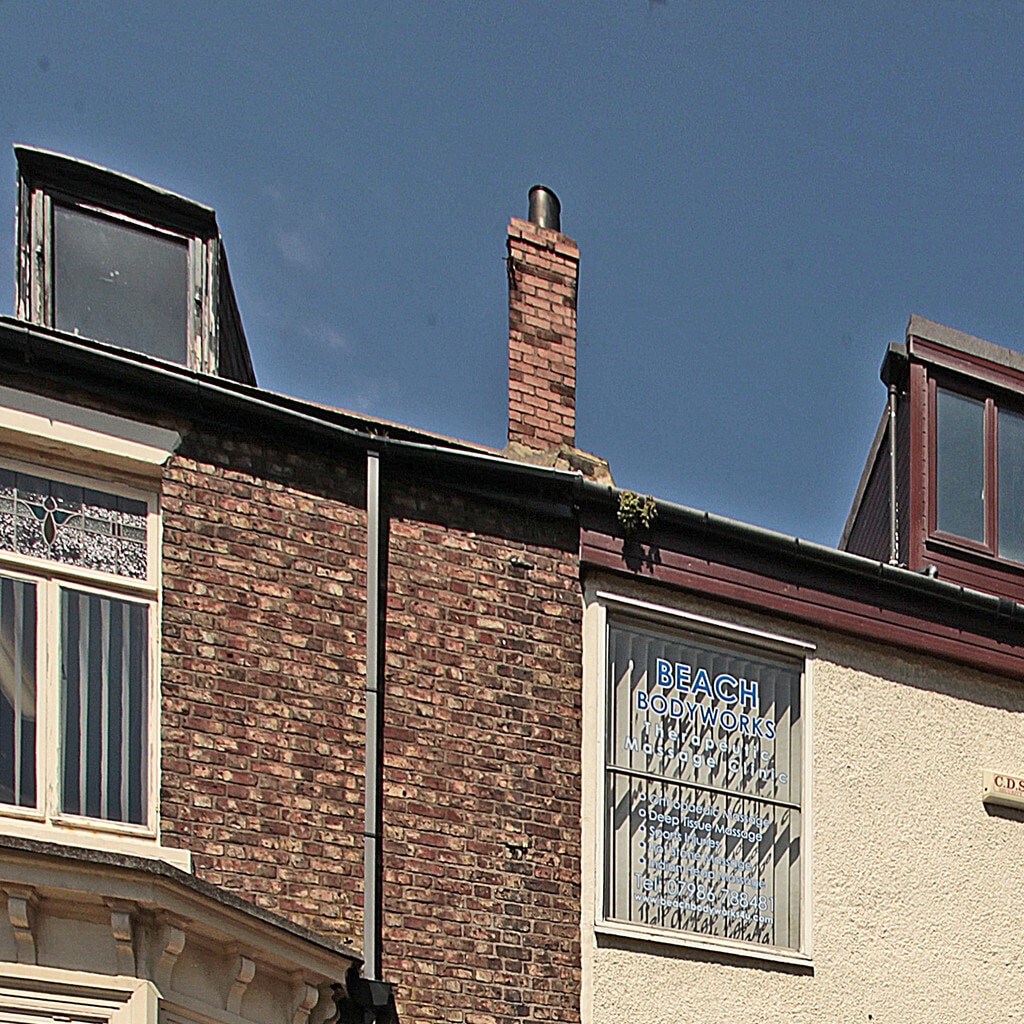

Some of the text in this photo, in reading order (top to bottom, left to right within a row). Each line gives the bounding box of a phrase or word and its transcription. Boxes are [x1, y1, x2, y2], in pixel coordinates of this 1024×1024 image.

[657, 658, 758, 708] BEACH
[637, 691, 776, 739] BODYWORKS
[645, 721, 771, 761] Therapeutic
[625, 736, 787, 784] Massage Clinic
[649, 794, 771, 829] Orthopaedic Massage
[649, 810, 763, 842] Deep Tissue Massage
[649, 825, 720, 849] Sports Injuries
[648, 857, 767, 889] Indian Head Massage
[704, 854, 753, 871] Massage
[634, 873, 774, 913] Tel: 07986 788481
[634, 893, 774, 925] www.beachbodyworks4u.com
